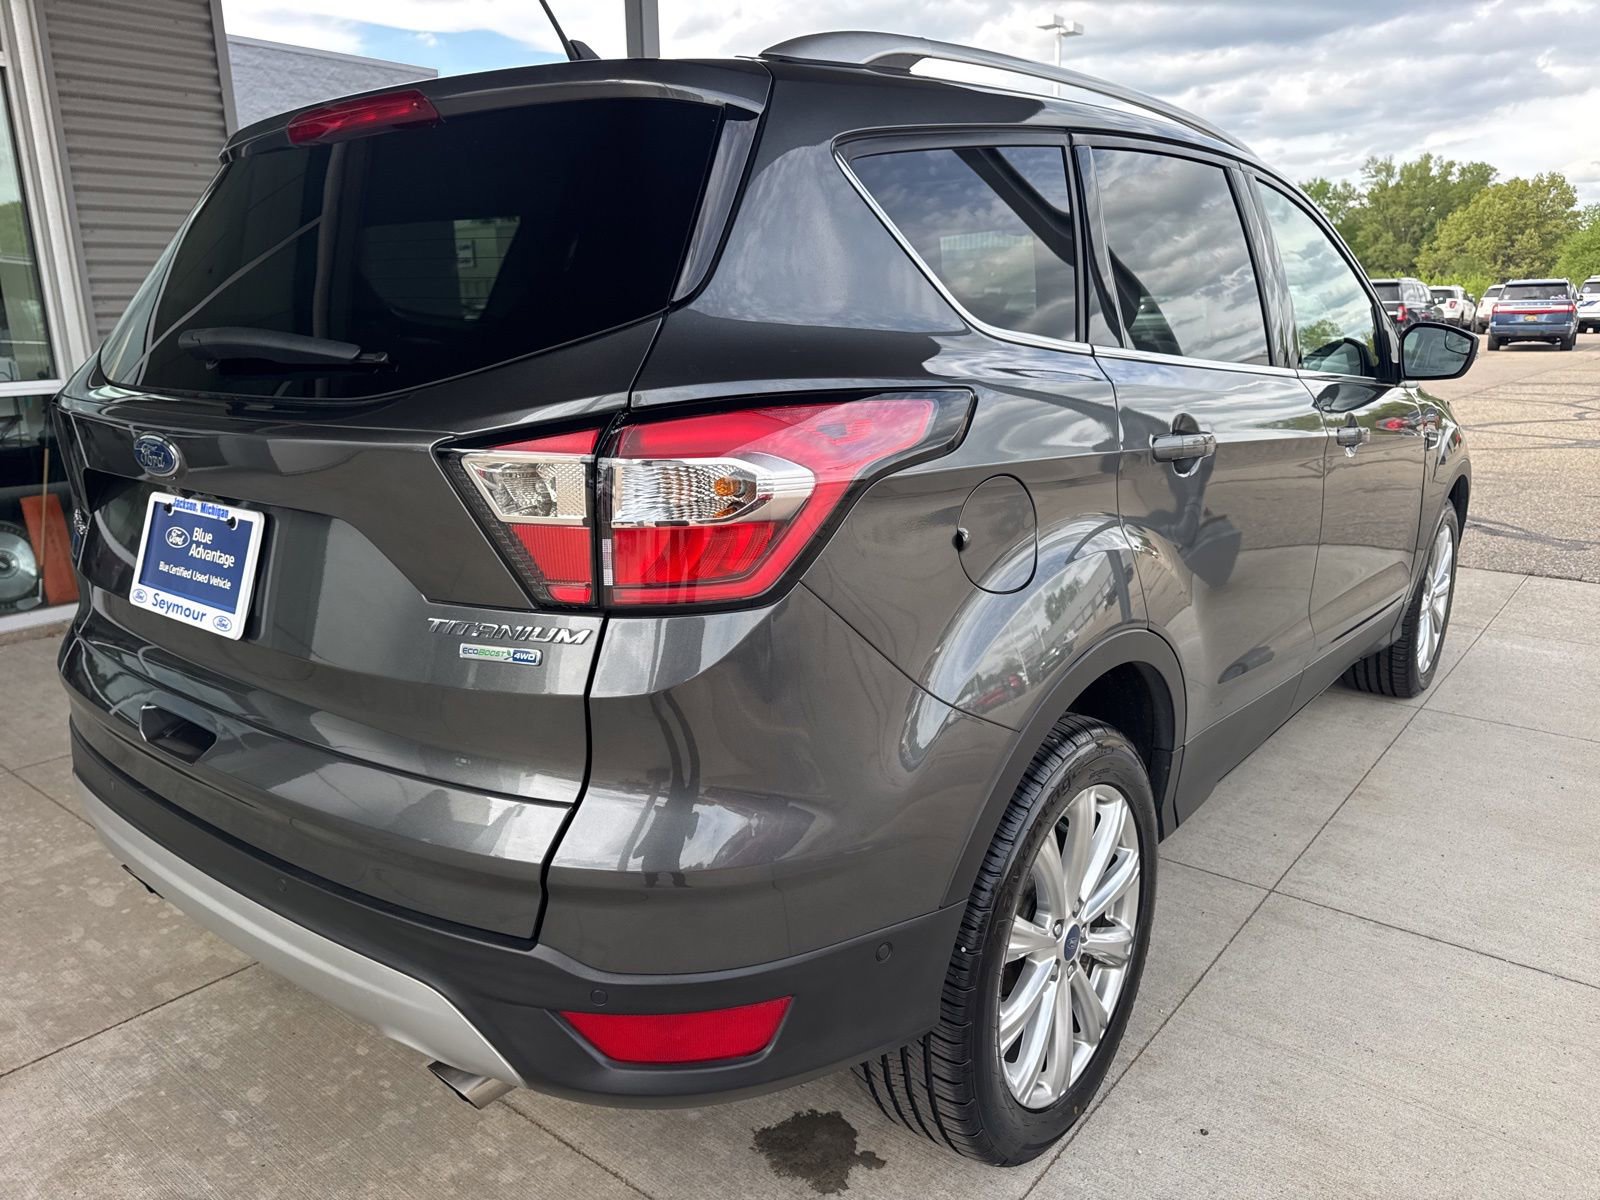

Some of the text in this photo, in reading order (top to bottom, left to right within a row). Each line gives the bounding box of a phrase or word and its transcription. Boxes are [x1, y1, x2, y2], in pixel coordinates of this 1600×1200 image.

[140, 443, 166, 468] Ford
[200, 502, 229, 520] Michigan
[192, 526, 213, 544] Blue
[188, 543, 235, 569] Advantage
[158, 561, 232, 590] Blue Certified Used Vehicle
[151, 592, 207, 622] Seymour
[427, 617, 593, 645] TITANIUM
[513, 652, 536, 661] 4WD
